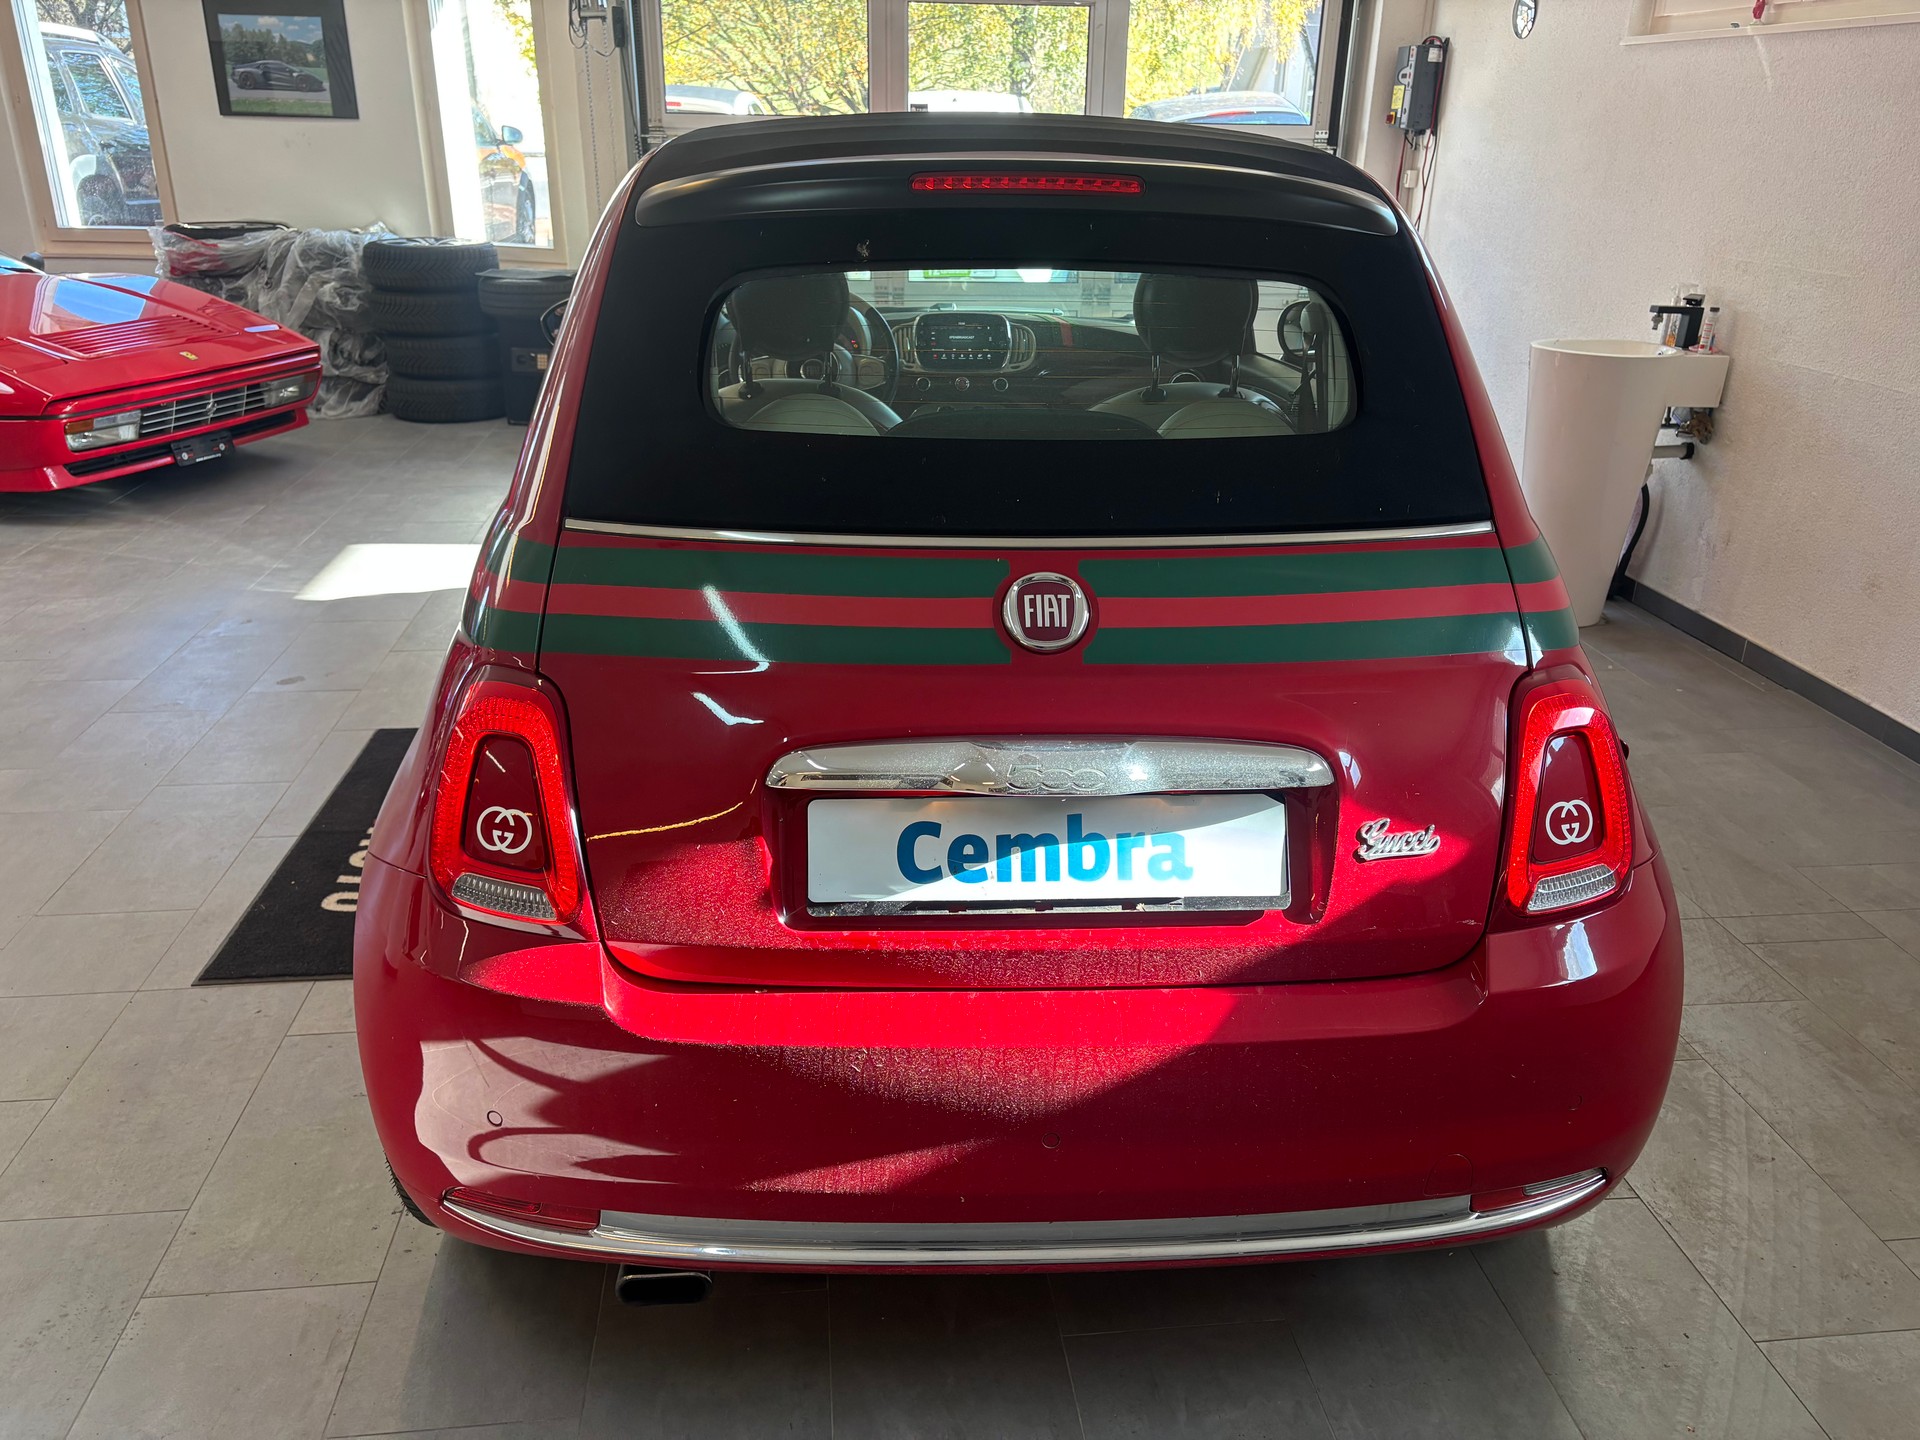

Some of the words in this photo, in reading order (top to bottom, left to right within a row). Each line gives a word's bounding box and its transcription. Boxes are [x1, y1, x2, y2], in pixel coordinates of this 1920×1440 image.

[1023, 594, 1071, 628] FIAT
[1006, 764, 1106, 791] 500
[896, 813, 1195, 884] Cembra
[1358, 818, 1441, 861] Gucci
